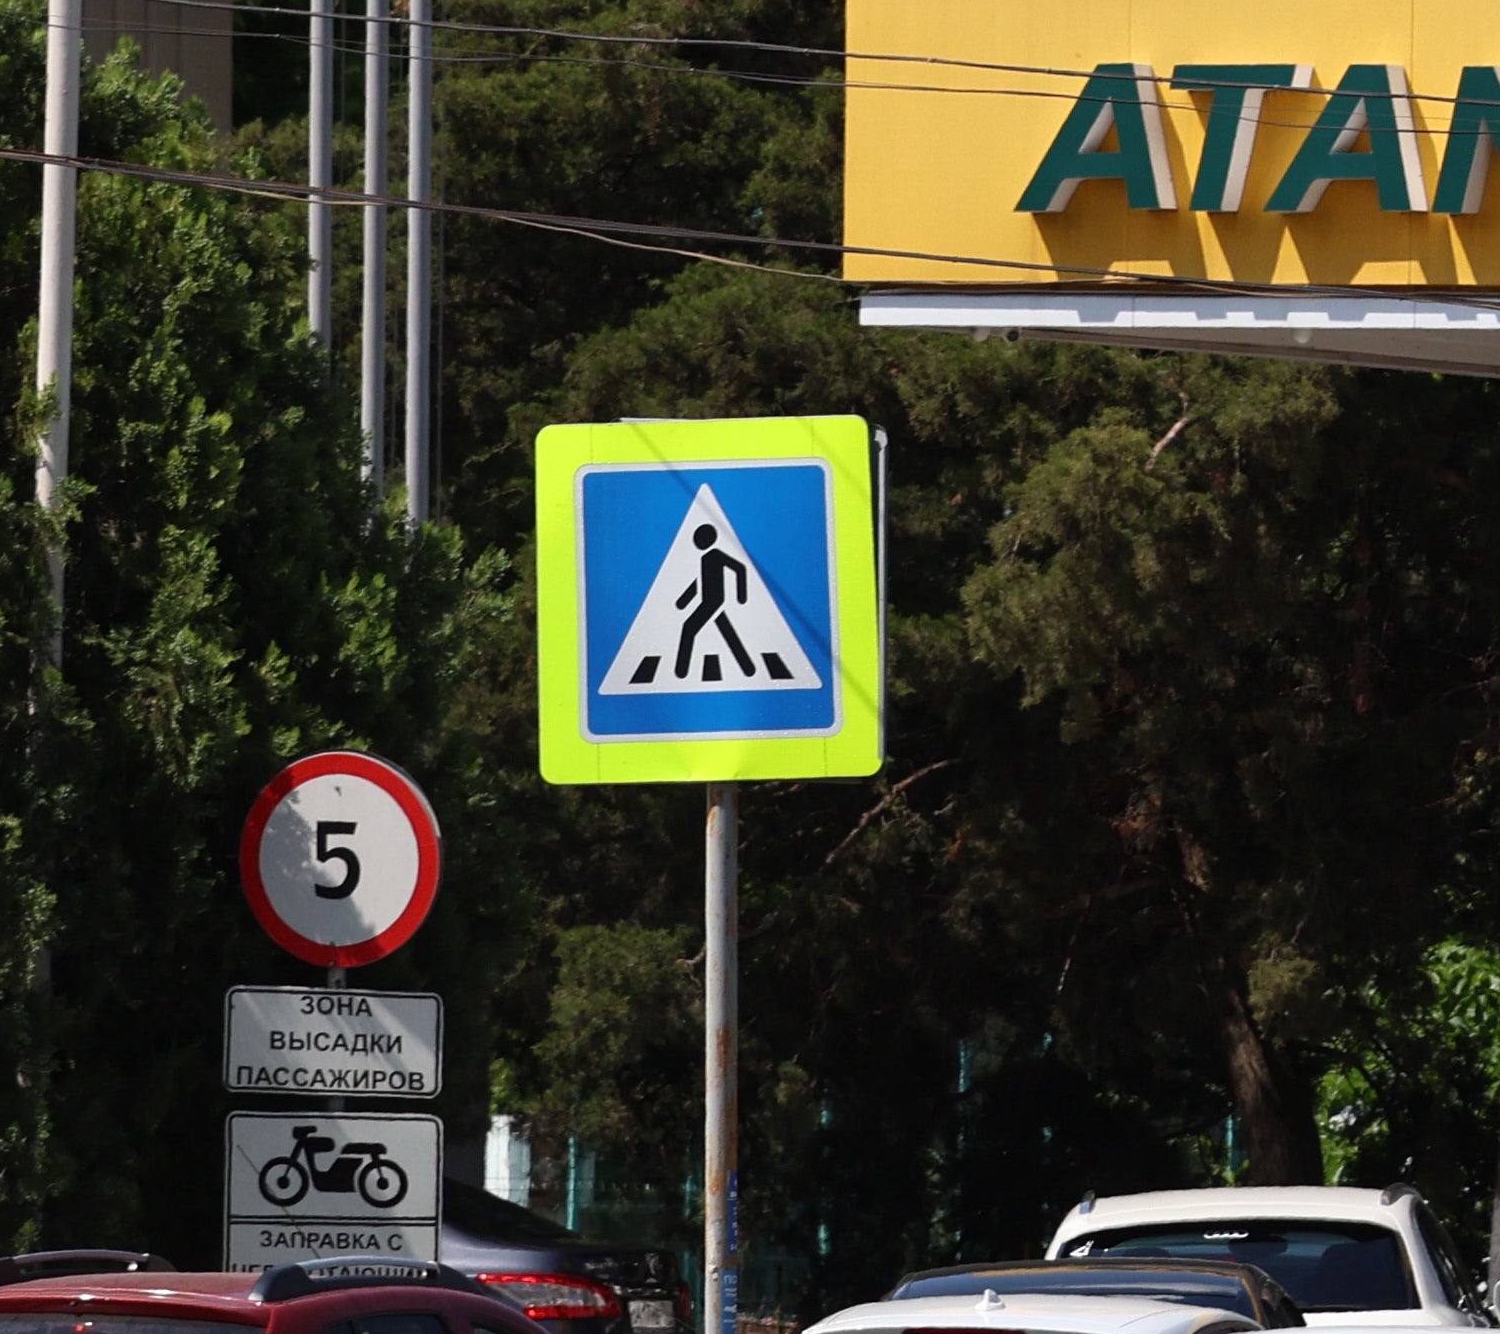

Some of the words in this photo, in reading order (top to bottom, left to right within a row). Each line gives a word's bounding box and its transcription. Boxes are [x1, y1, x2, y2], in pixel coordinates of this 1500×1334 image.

[313, 821, 361, 900] 5
[300, 995, 373, 1018] ЗОНА
[269, 1030, 402, 1057] ВЫСАДКИ
[236, 1065, 425, 1091] ПАССАЖИРОВ
[261, 1230, 381, 1250] ЗАПРАВКА
[388, 1233, 404, 1251] С
